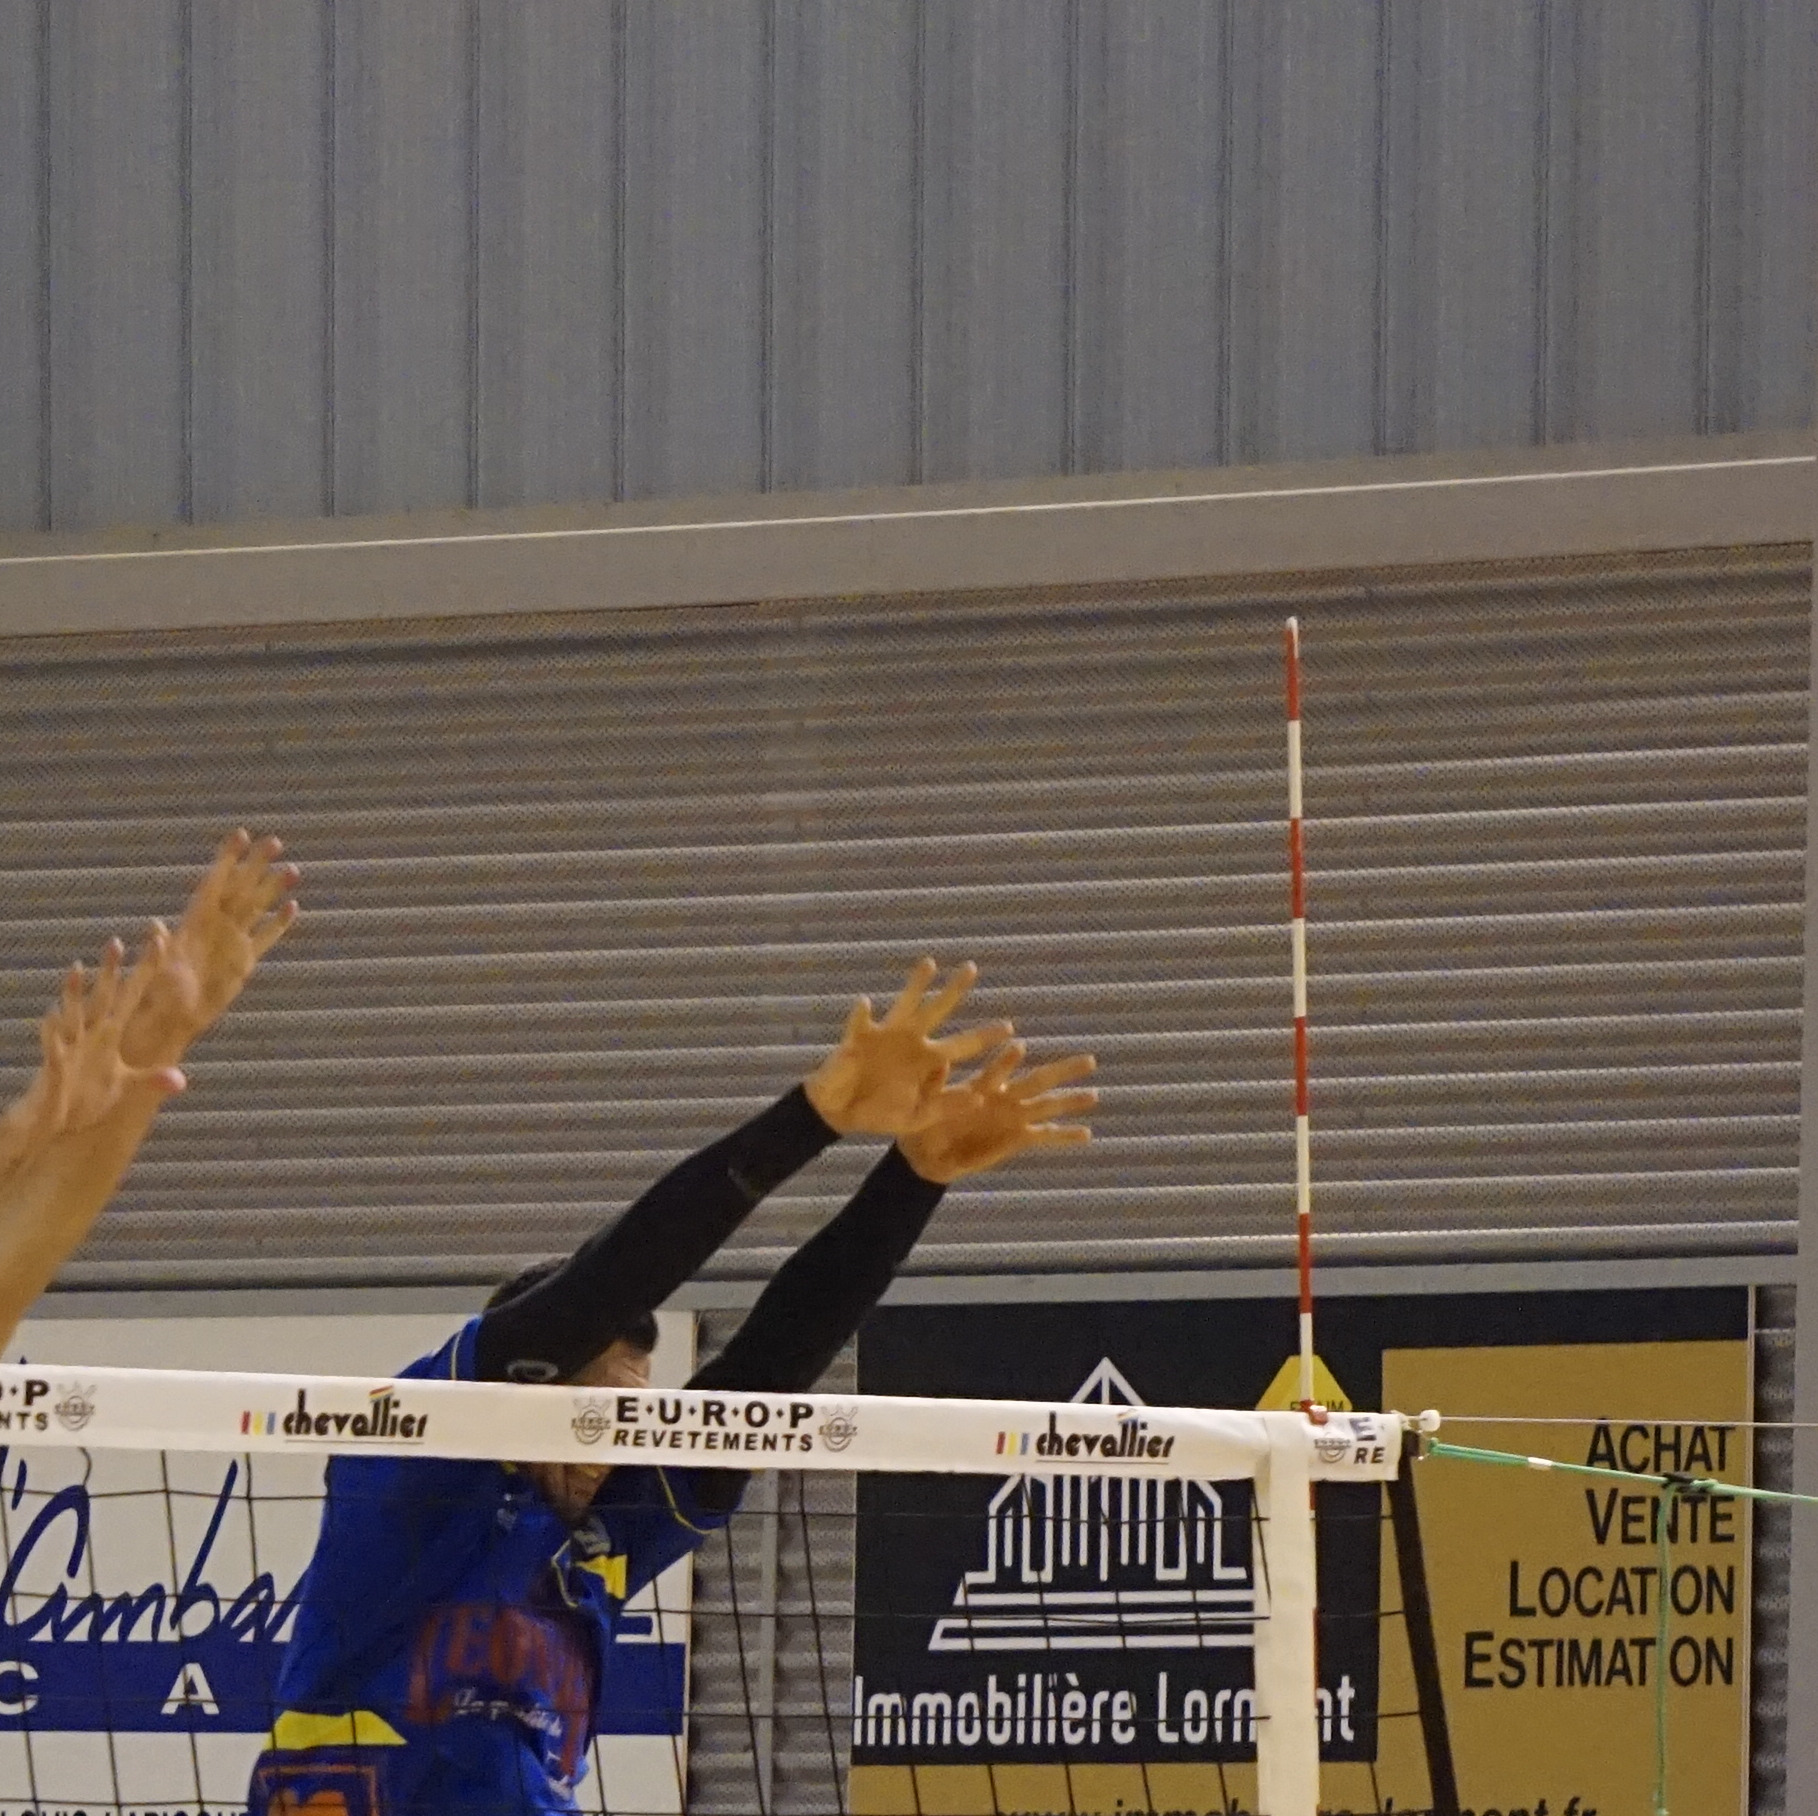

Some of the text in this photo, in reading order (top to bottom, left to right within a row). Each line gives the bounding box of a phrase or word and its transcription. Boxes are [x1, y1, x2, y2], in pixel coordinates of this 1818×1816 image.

[283, 1388, 428, 1438] chevallier
[1036, 1411, 1176, 1461] chevallier
[614, 1428, 814, 1453] REVETEMENTS
[1586, 1487, 1735, 1546] VENTE
[1509, 1560, 1735, 1618] LOCATON
[1464, 1631, 1734, 1689] ESTIMATON
